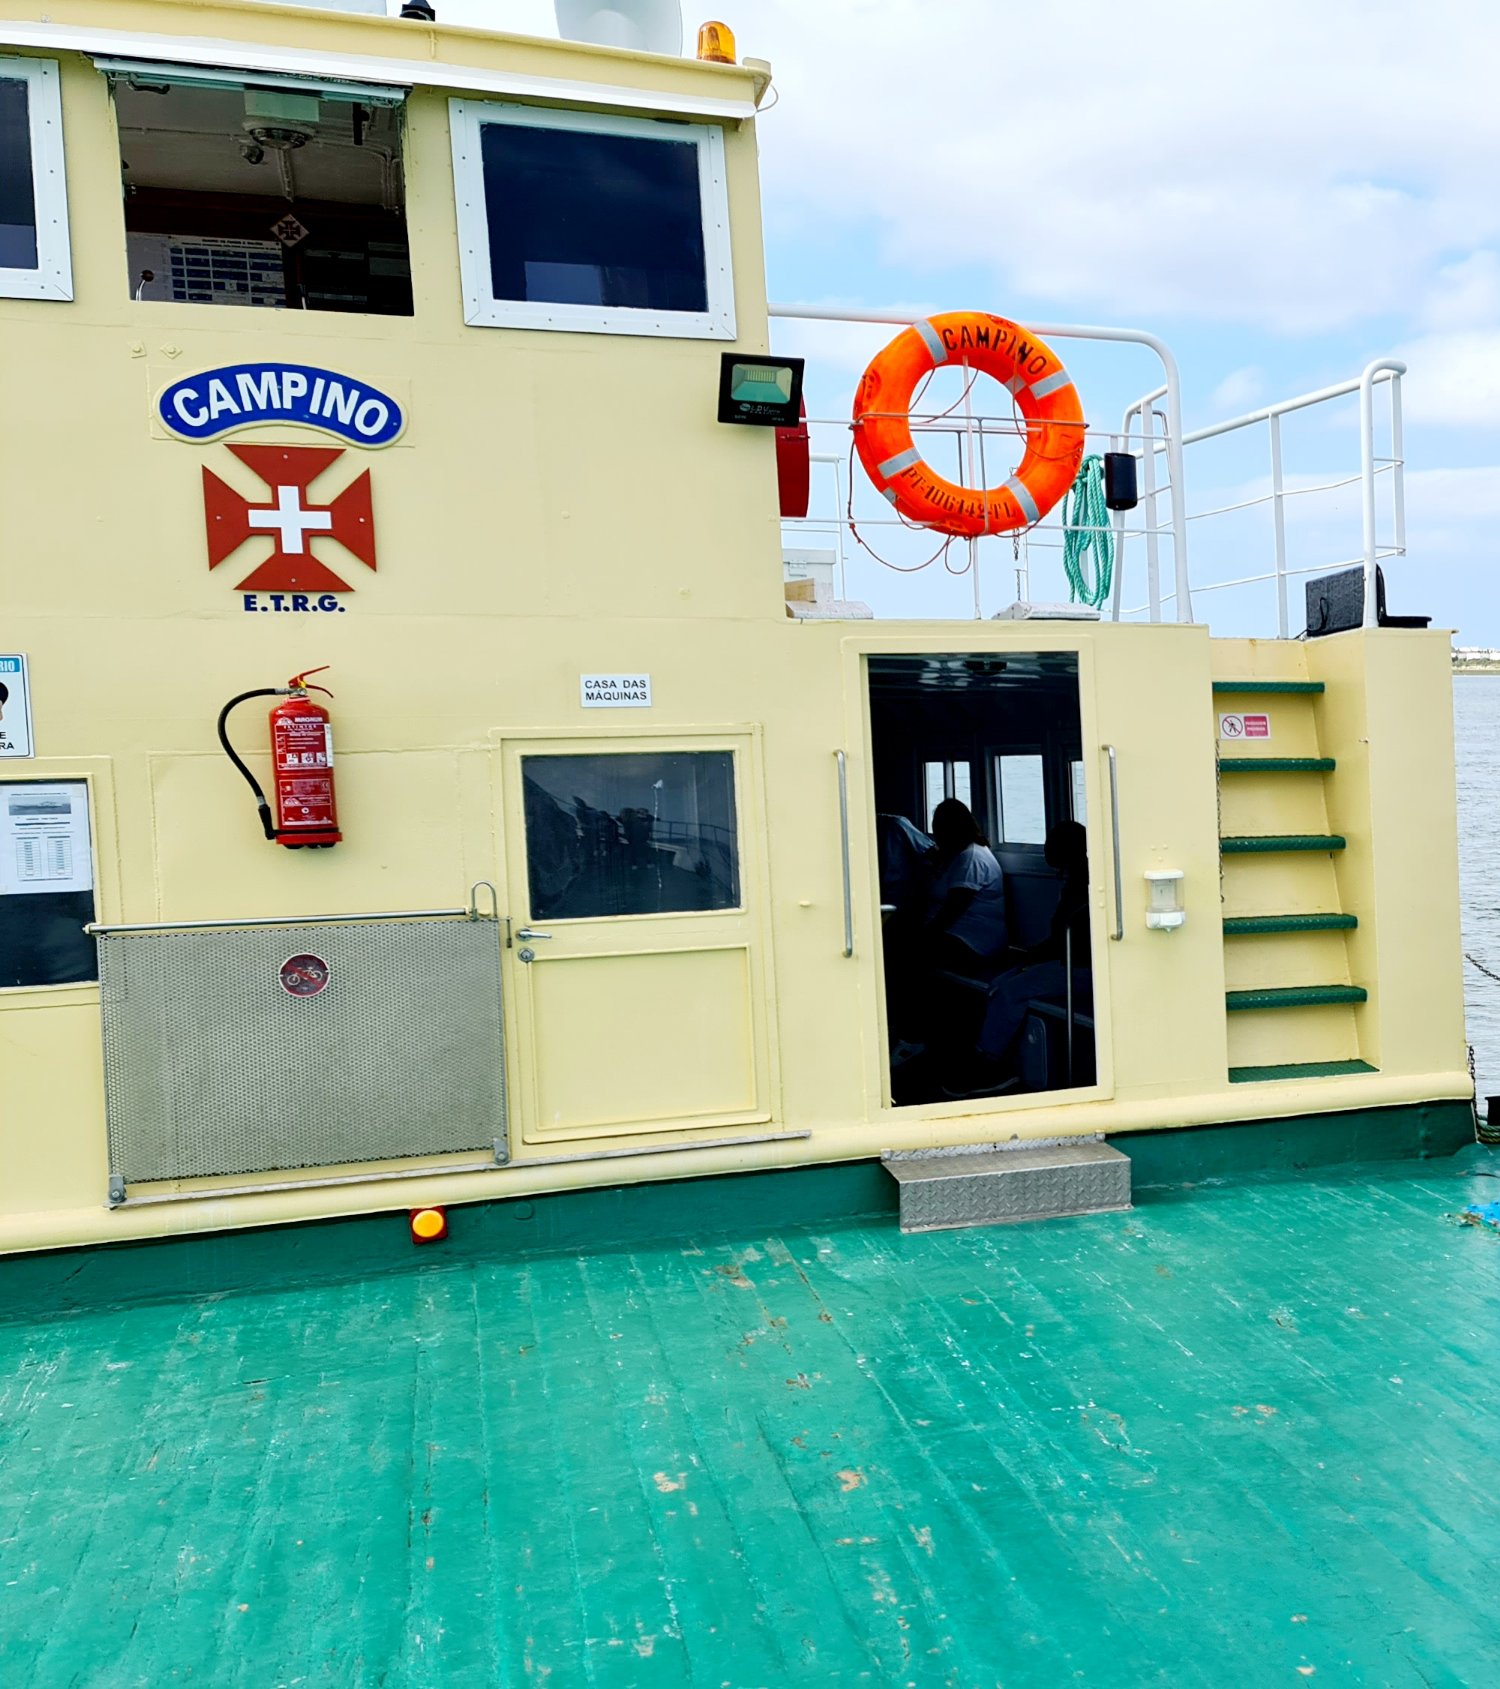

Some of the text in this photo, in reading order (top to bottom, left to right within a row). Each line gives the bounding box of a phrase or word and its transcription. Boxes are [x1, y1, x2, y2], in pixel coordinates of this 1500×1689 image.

[942, 325, 1047, 376] CAMPINO
[173, 371, 389, 436] CAMPINO
[244, 595, 346, 613] E.T.R.G.
[585, 679, 647, 689] CASA DAS
[585, 689, 647, 701] MÁQUINAS
